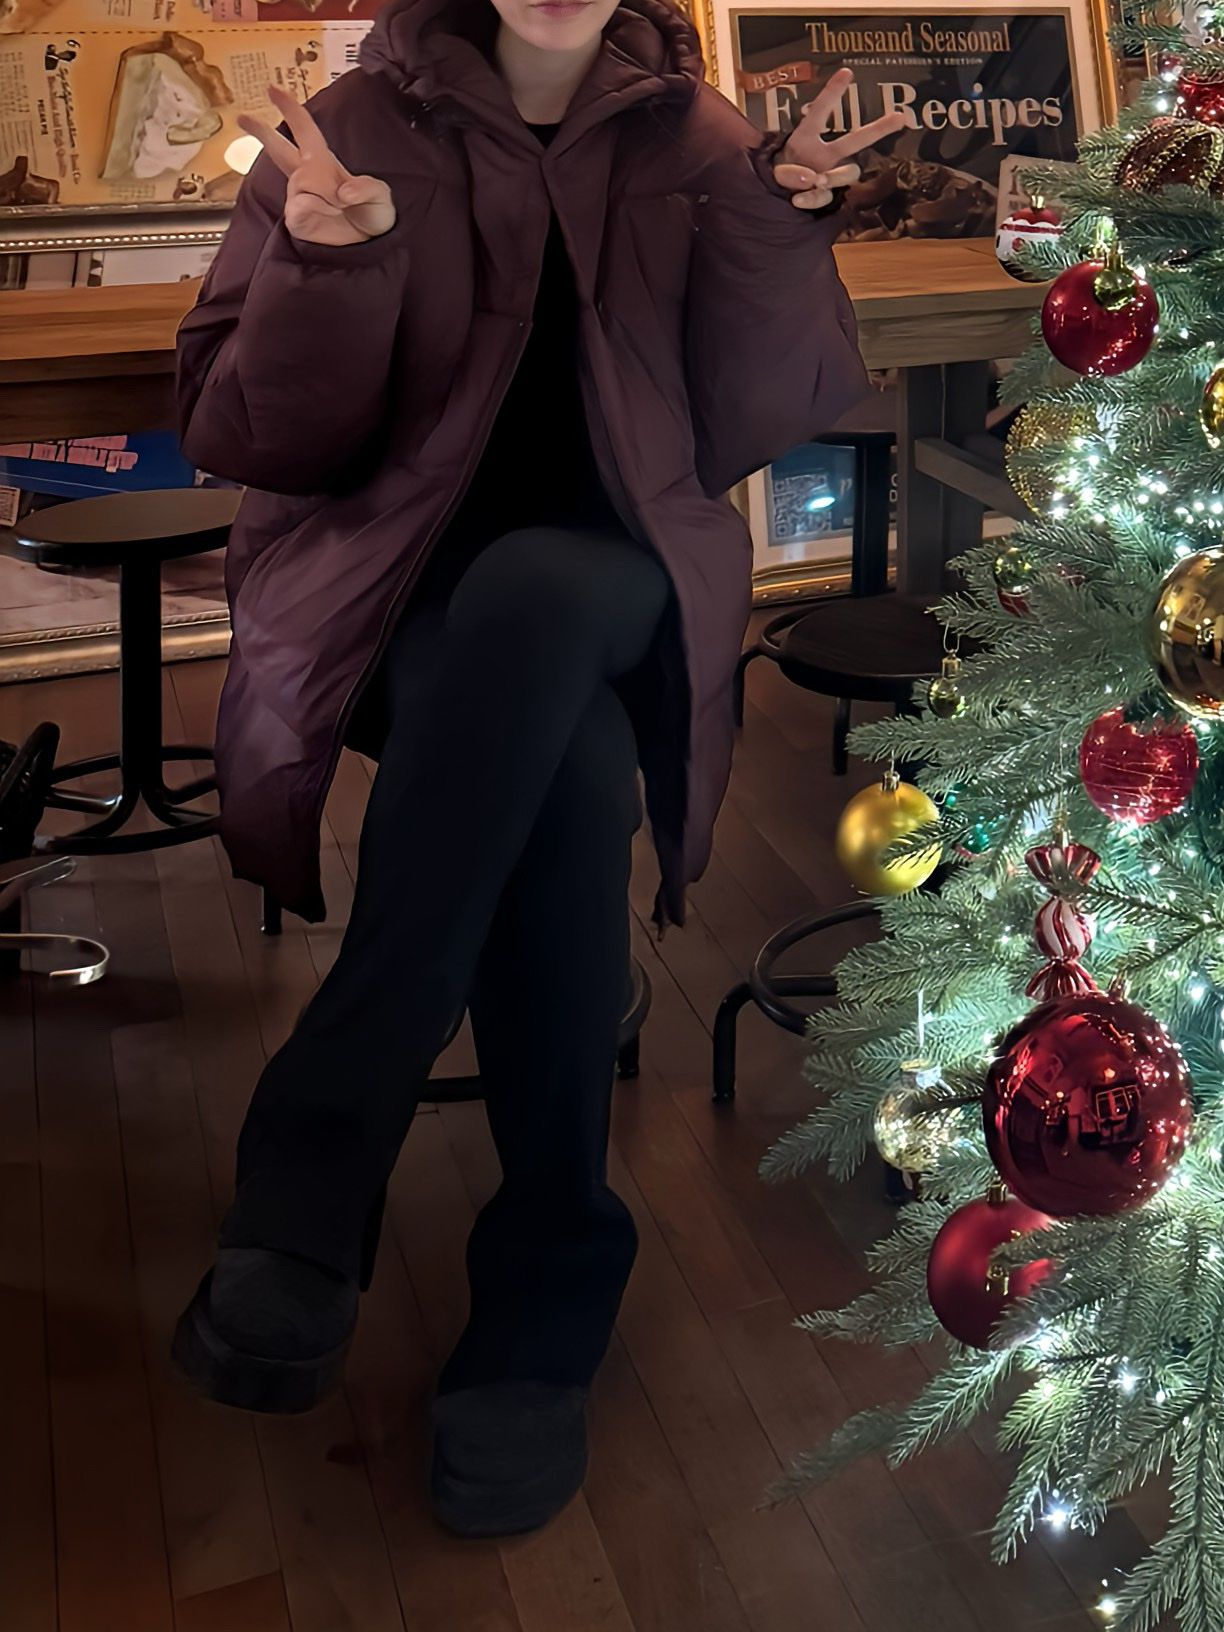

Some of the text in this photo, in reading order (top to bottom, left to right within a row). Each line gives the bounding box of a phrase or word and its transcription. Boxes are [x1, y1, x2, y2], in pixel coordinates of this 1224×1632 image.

[805, 22, 1011, 53] Thousand Seasonal
[753, 67, 799, 89] BEST
[765, 82, 1063, 146] Fll Recipes
